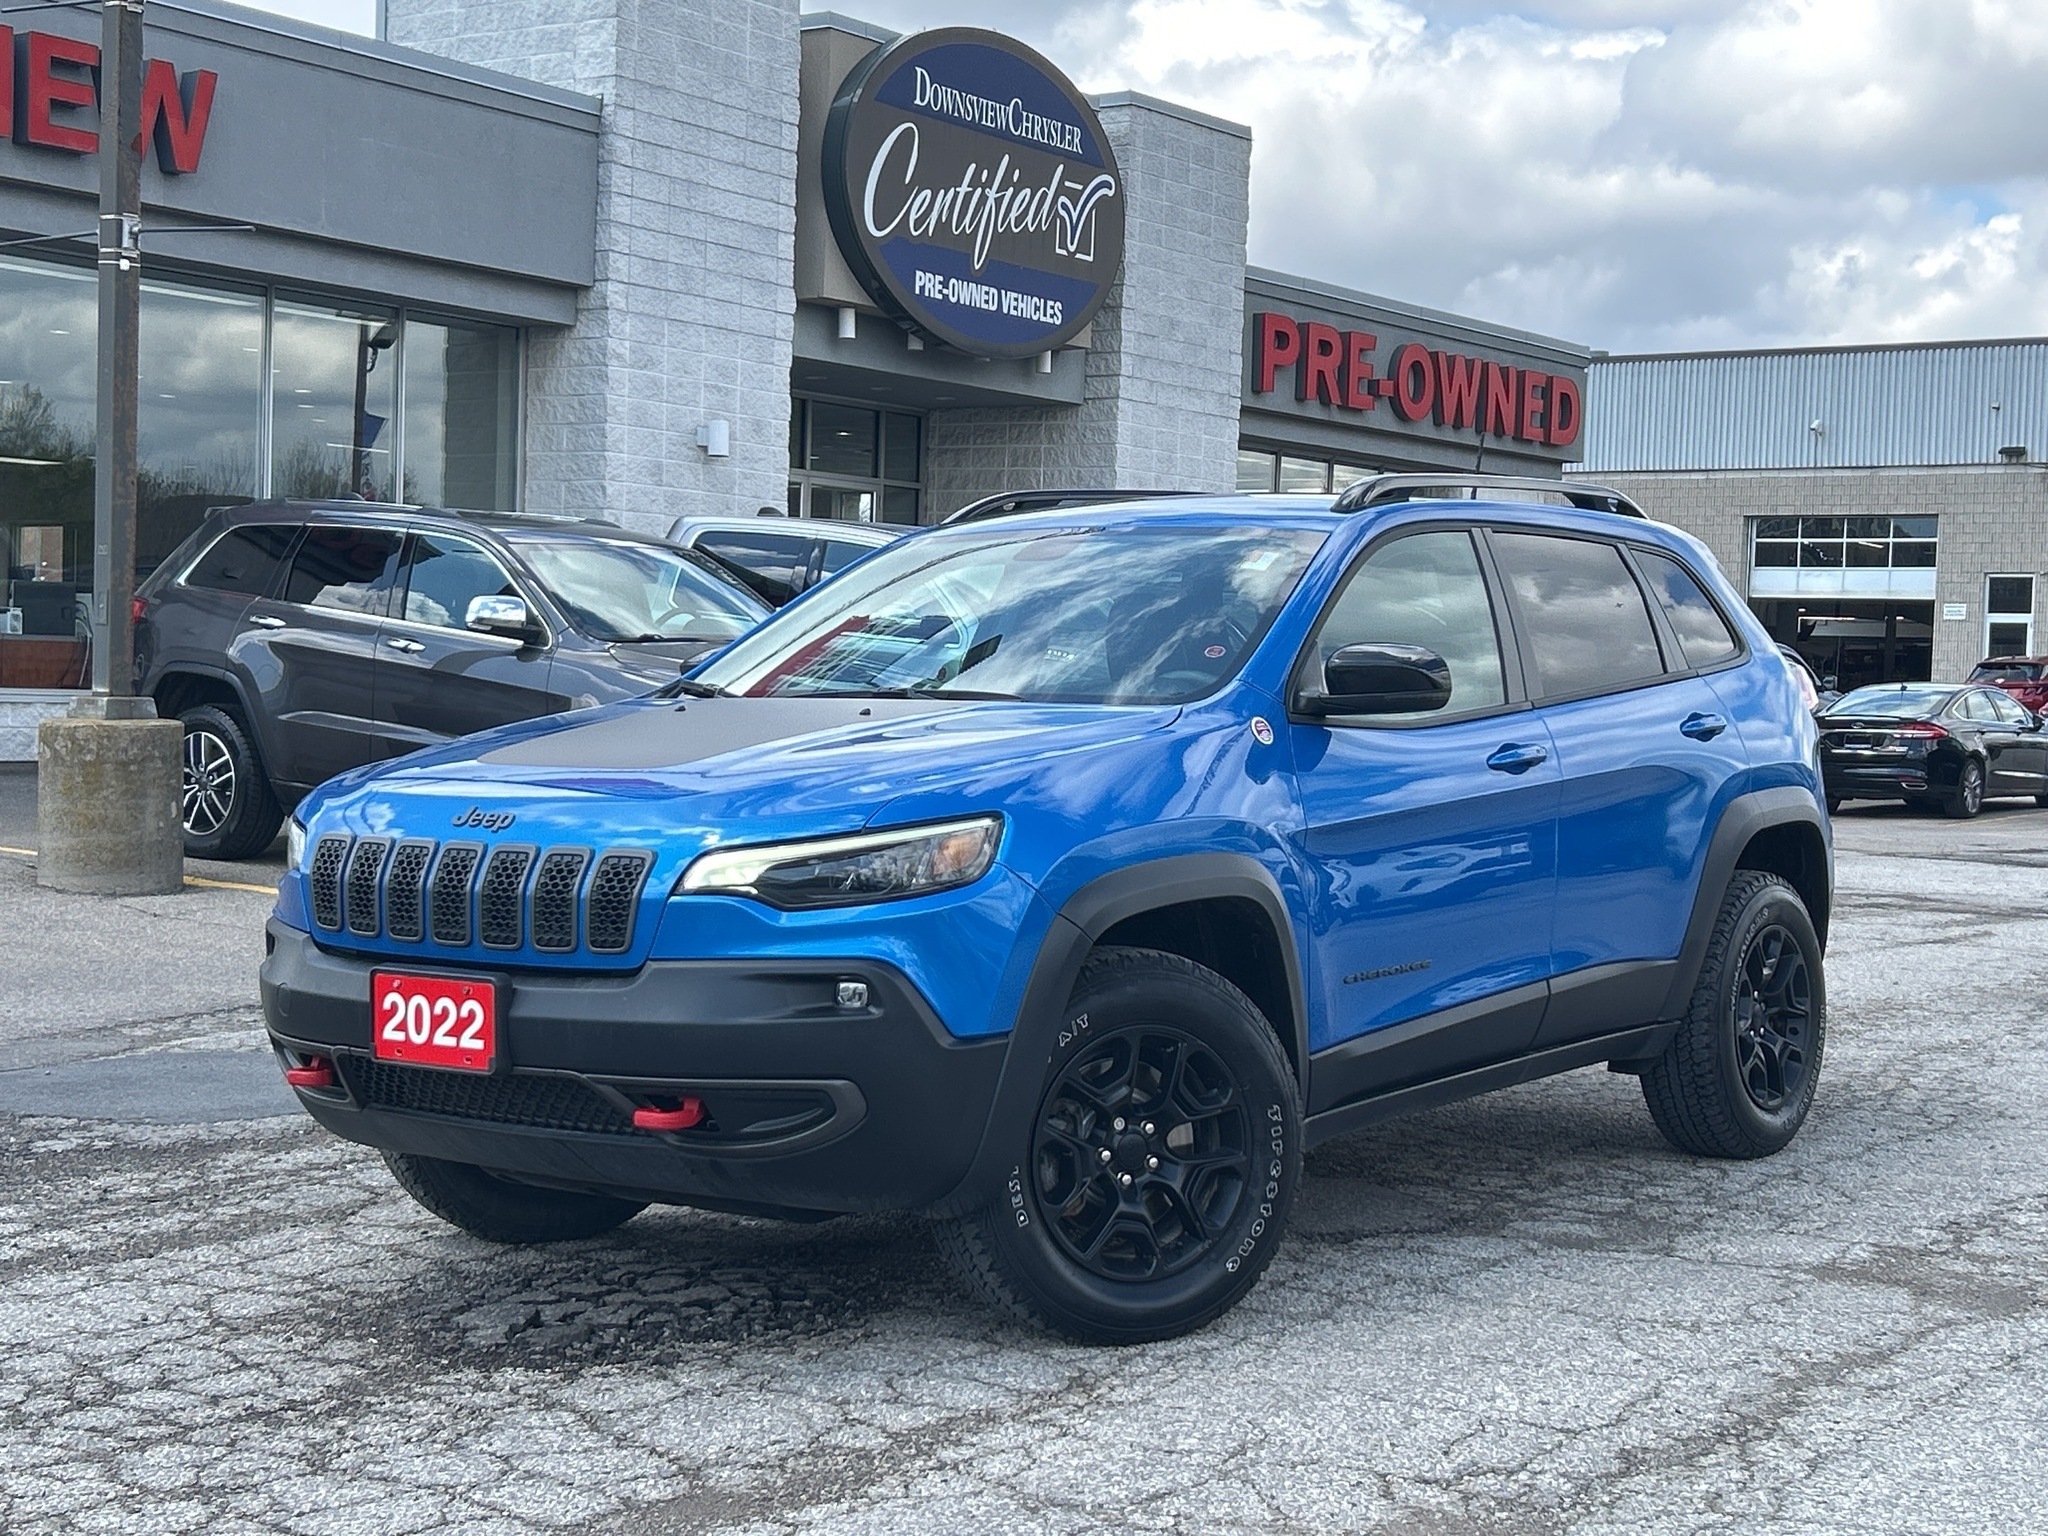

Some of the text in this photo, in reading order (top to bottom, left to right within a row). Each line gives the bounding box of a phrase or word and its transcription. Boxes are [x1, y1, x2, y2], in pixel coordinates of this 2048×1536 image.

[864, 122, 1065, 270] Certified
[915, 270, 1063, 326] PRE-OWNED VEHICLES
[1253, 312, 1581, 446] PRE-OWNED
[451, 806, 516, 834] Jeep
[382, 991, 485, 1051] 2022
[1058, 1013, 1089, 1047] A/T
